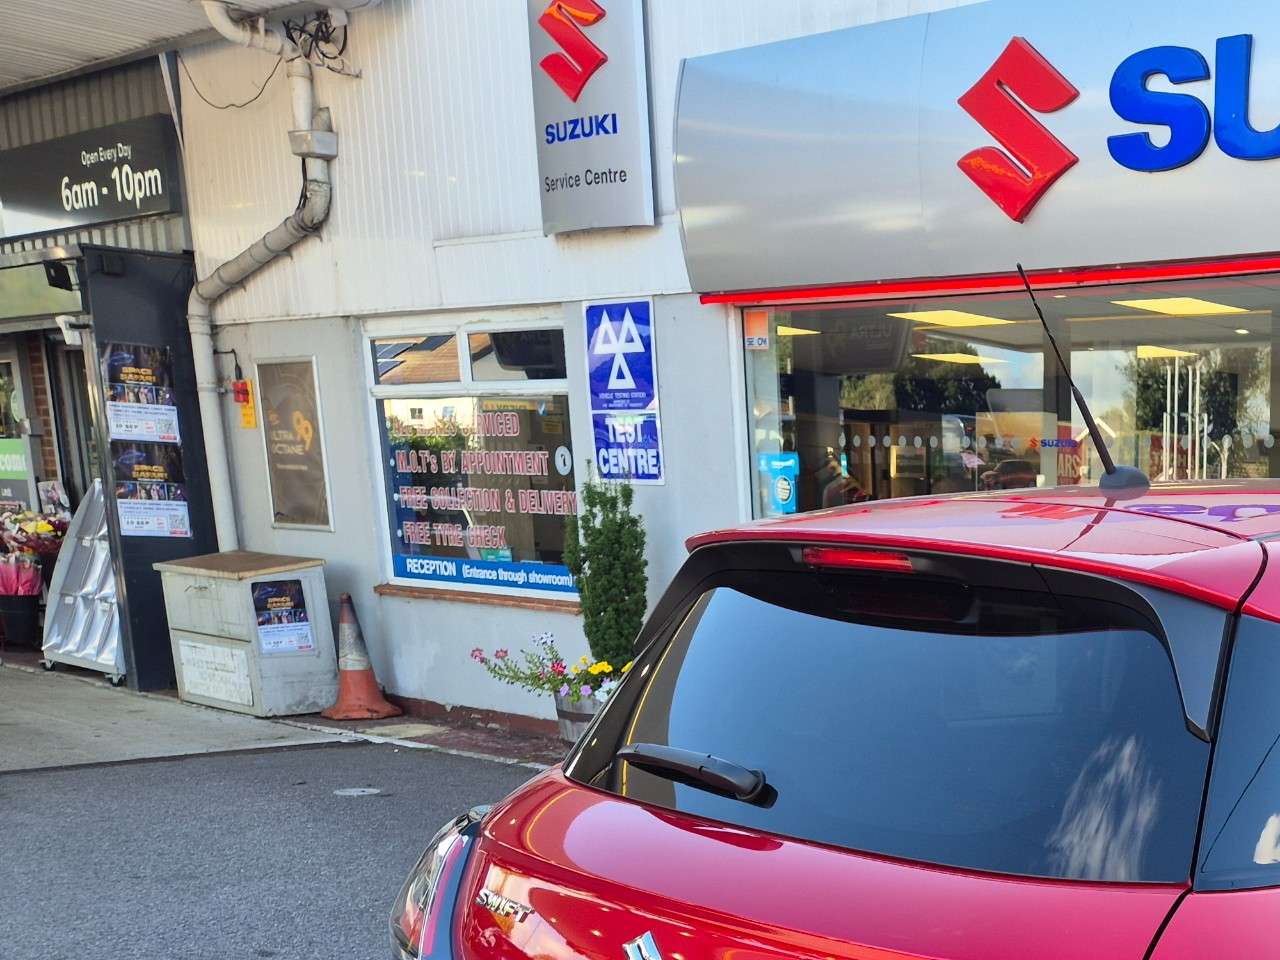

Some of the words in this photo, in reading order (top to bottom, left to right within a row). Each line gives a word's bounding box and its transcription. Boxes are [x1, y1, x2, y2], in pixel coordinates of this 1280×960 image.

[545, 113, 618, 145] SUZUKI
[81, 150, 99, 168] Open
[99, 147, 117, 162] Every
[117, 142, 132, 160] Day
[61, 176, 98, 212] 6am
[111, 163, 163, 210] 10pm
[544, 172, 581, 193] Service
[584, 167, 628, 186] Centre
[605, 416, 644, 443] TEST
[440, 450, 456, 474] BY
[461, 450, 550, 476] APPOINTMENT
[598, 447, 659, 474] CENTRE
[399, 485, 428, 510] FREE
[430, 486, 501, 513] COLLECTION
[505, 488, 516, 514] &
[518, 489, 577, 516] DELIVERY
[402, 520, 431, 545] FREE
[432, 522, 464, 548] TYRE
[466, 524, 507, 549] CHECK
[406, 558, 457, 577] RECEPTION
[462, 564, 497, 580] (Entrance
[497, 567, 528, 585] through
[528, 569, 573, 586] showroom)
[475, 888, 535, 923] SWIFT
